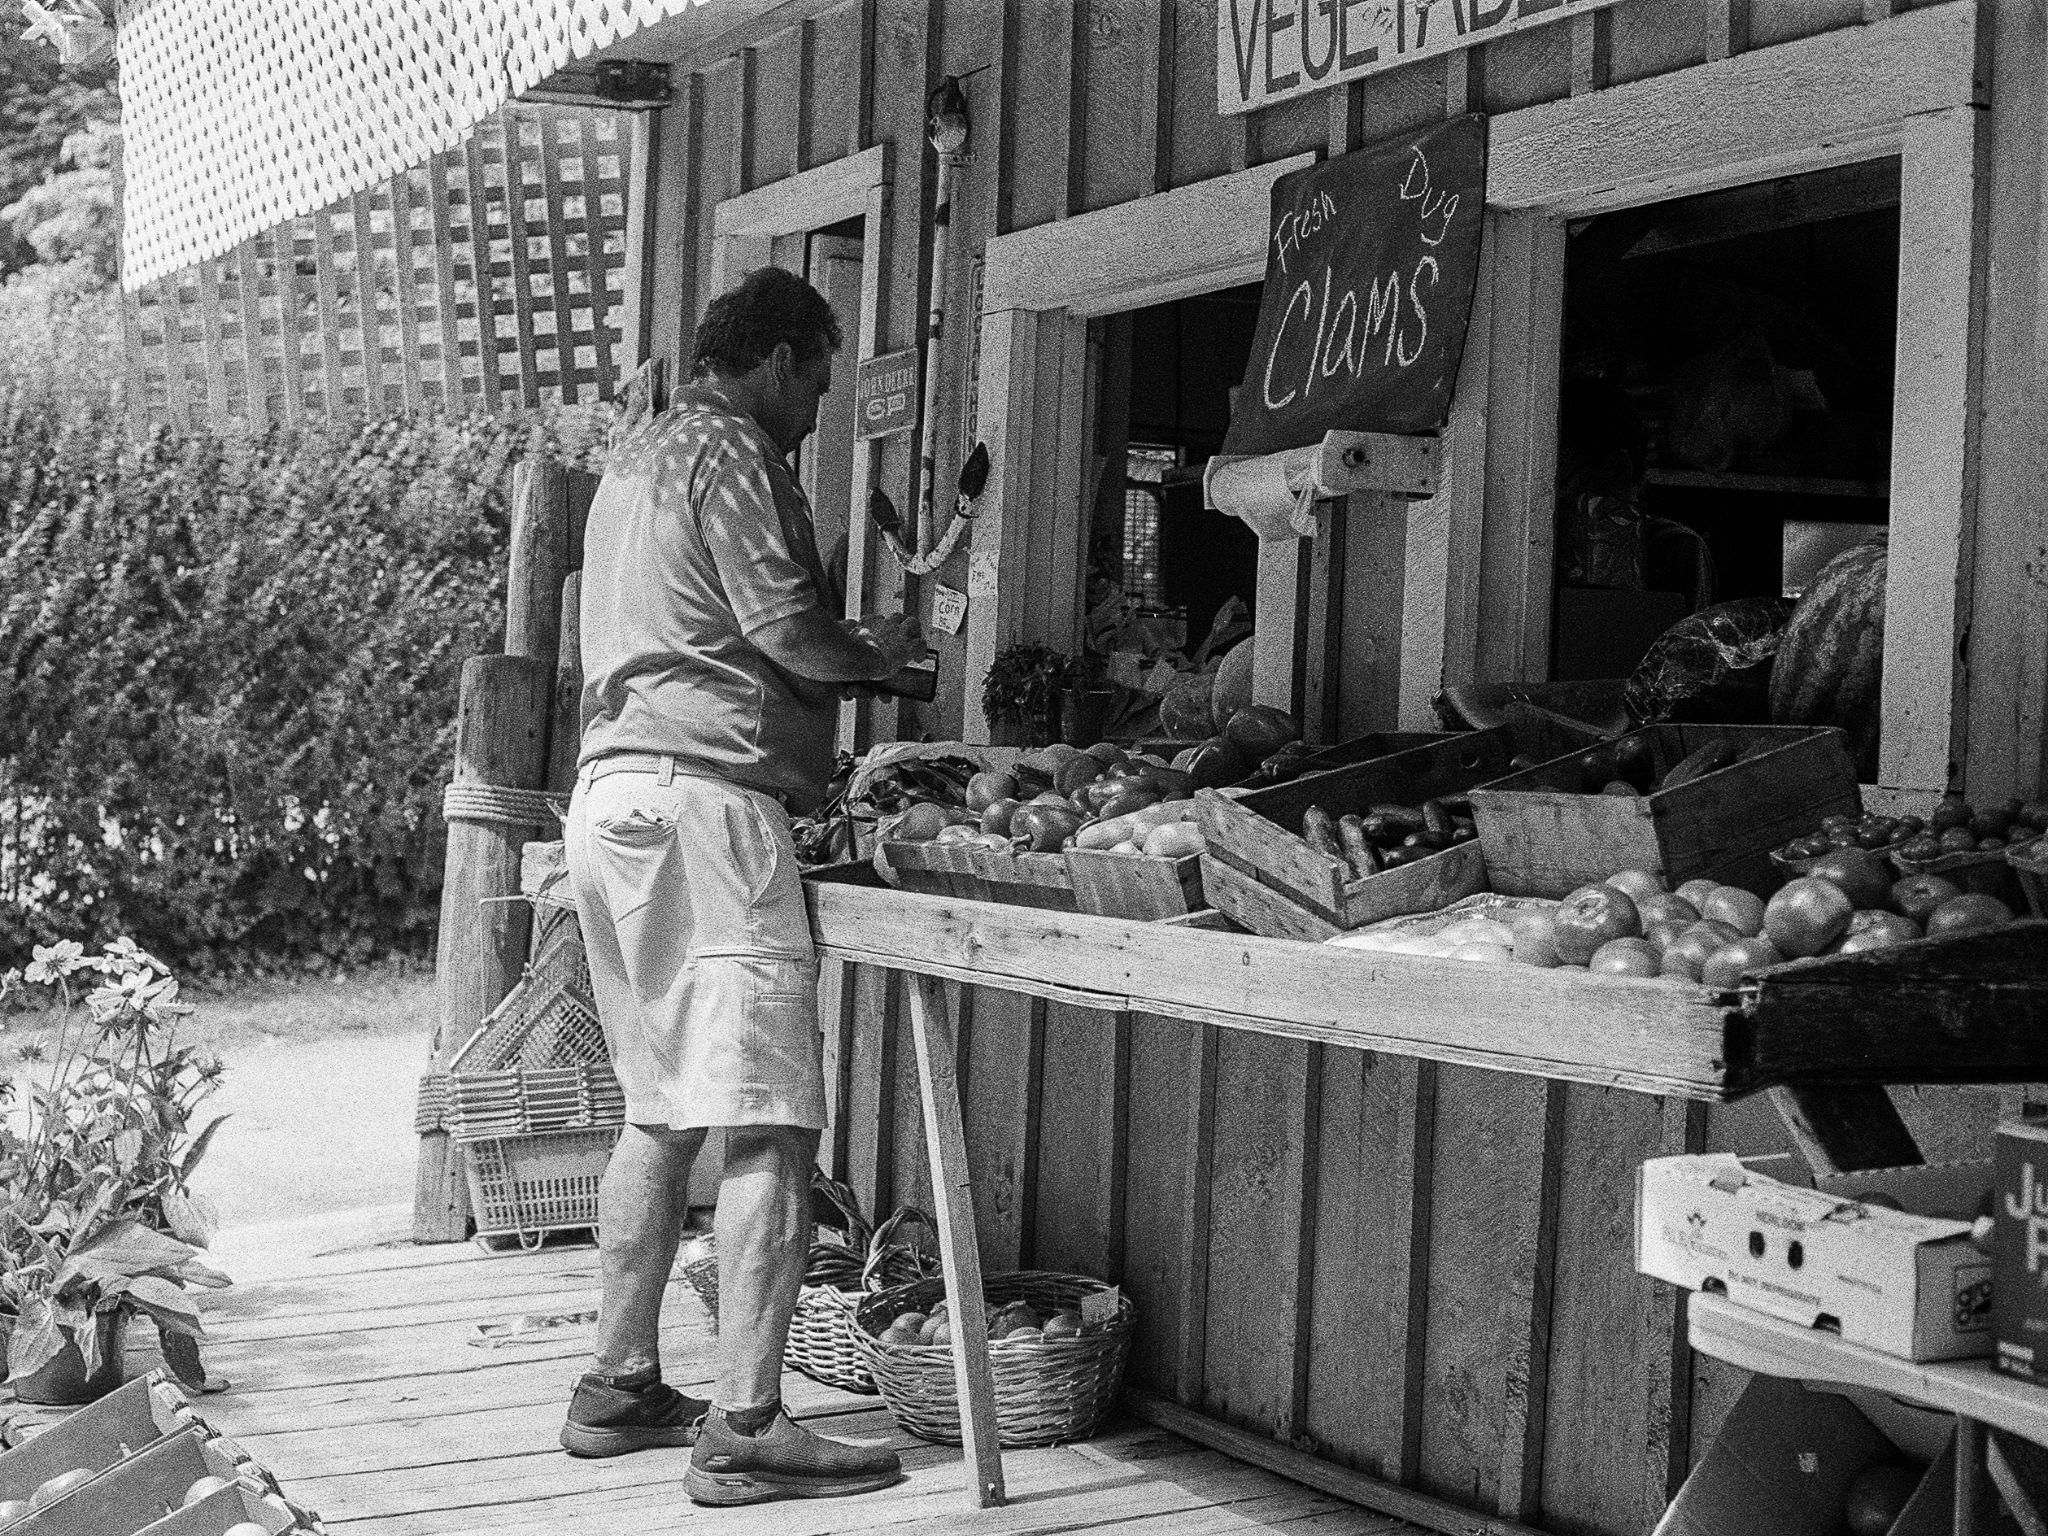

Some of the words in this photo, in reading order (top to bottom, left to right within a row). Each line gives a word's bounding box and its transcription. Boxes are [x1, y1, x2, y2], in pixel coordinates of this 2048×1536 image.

[1274, 191, 1337, 273] Fresh
[1400, 145, 1460, 246] Dug
[970, 272, 985, 382] LOCAL
